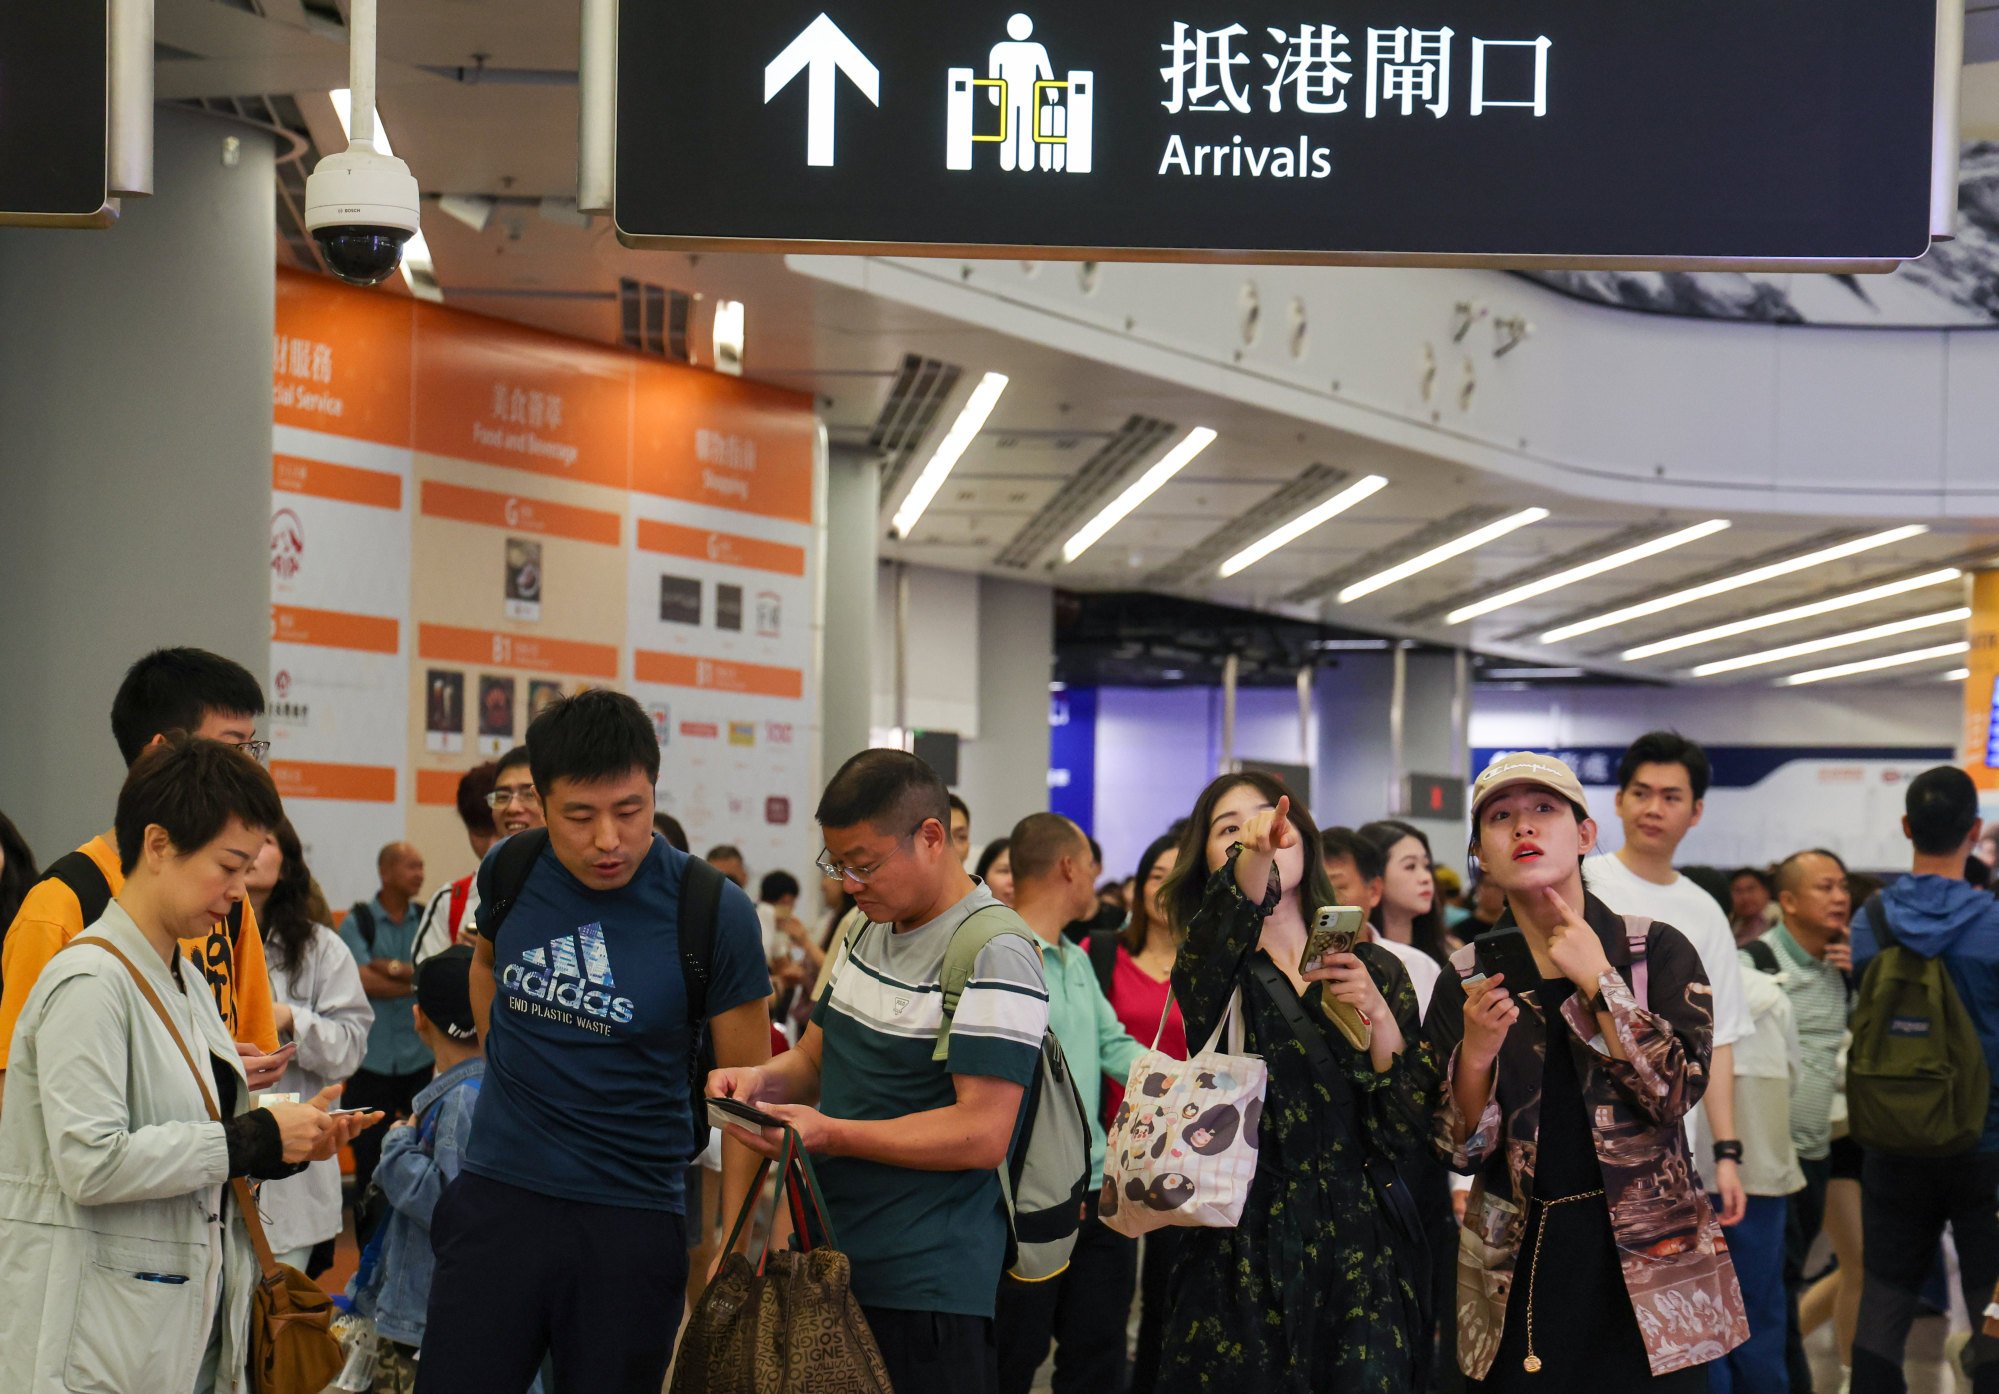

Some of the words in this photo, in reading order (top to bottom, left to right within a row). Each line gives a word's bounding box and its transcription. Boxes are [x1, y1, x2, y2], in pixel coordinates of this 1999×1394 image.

[1159, 21, 1553, 119] 抵港閘口
[1158, 134, 1332, 179] Arrivals
[1483, 763, 1563, 781] Champion
[503, 963, 635, 1023] adidas
[509, 996, 528, 1013] END
[531, 1003, 573, 1025] PLASTIC
[576, 1015, 612, 1037] WASTE
